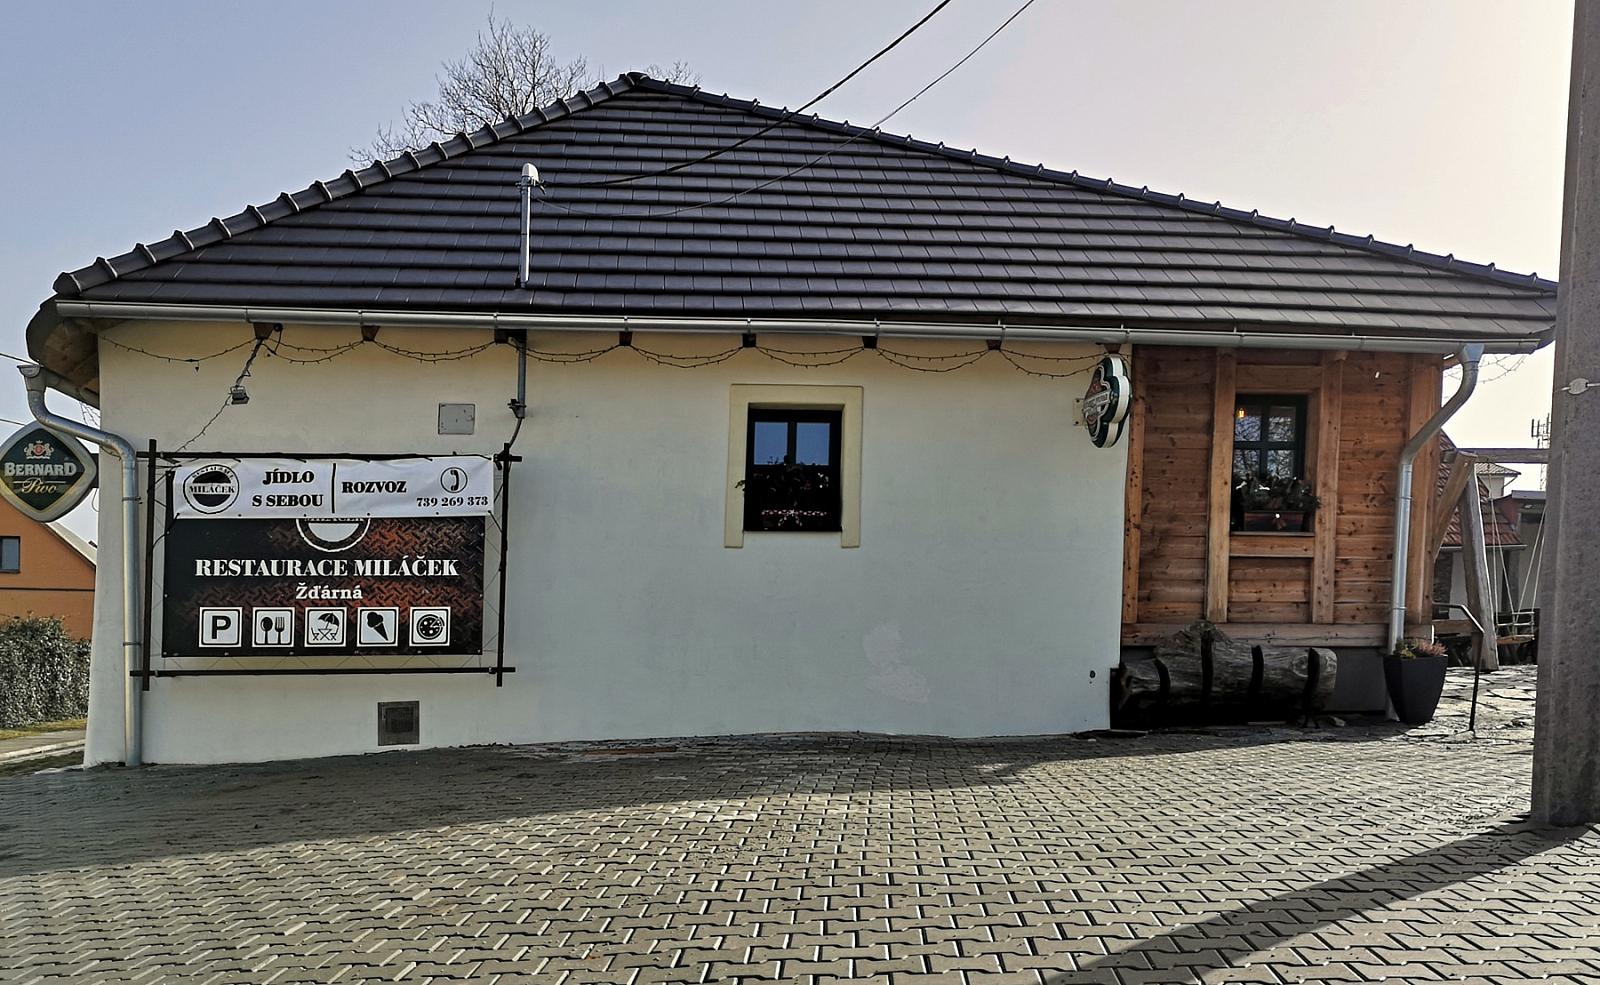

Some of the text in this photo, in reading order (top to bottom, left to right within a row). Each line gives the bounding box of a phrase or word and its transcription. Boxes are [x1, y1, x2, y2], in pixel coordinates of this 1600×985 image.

[4, 462, 77, 477] BERNARD
[262, 468, 315, 485] JÍDLO
[341, 480, 407, 494] ROZVOZ
[252, 494, 324, 507] S SEBOU
[416, 496, 489, 507] 739 269 373
[195, 555, 460, 577] RESTAURACE MILÁČEK
[295, 582, 363, 600] Žďárná
[211, 615, 232, 640] P
